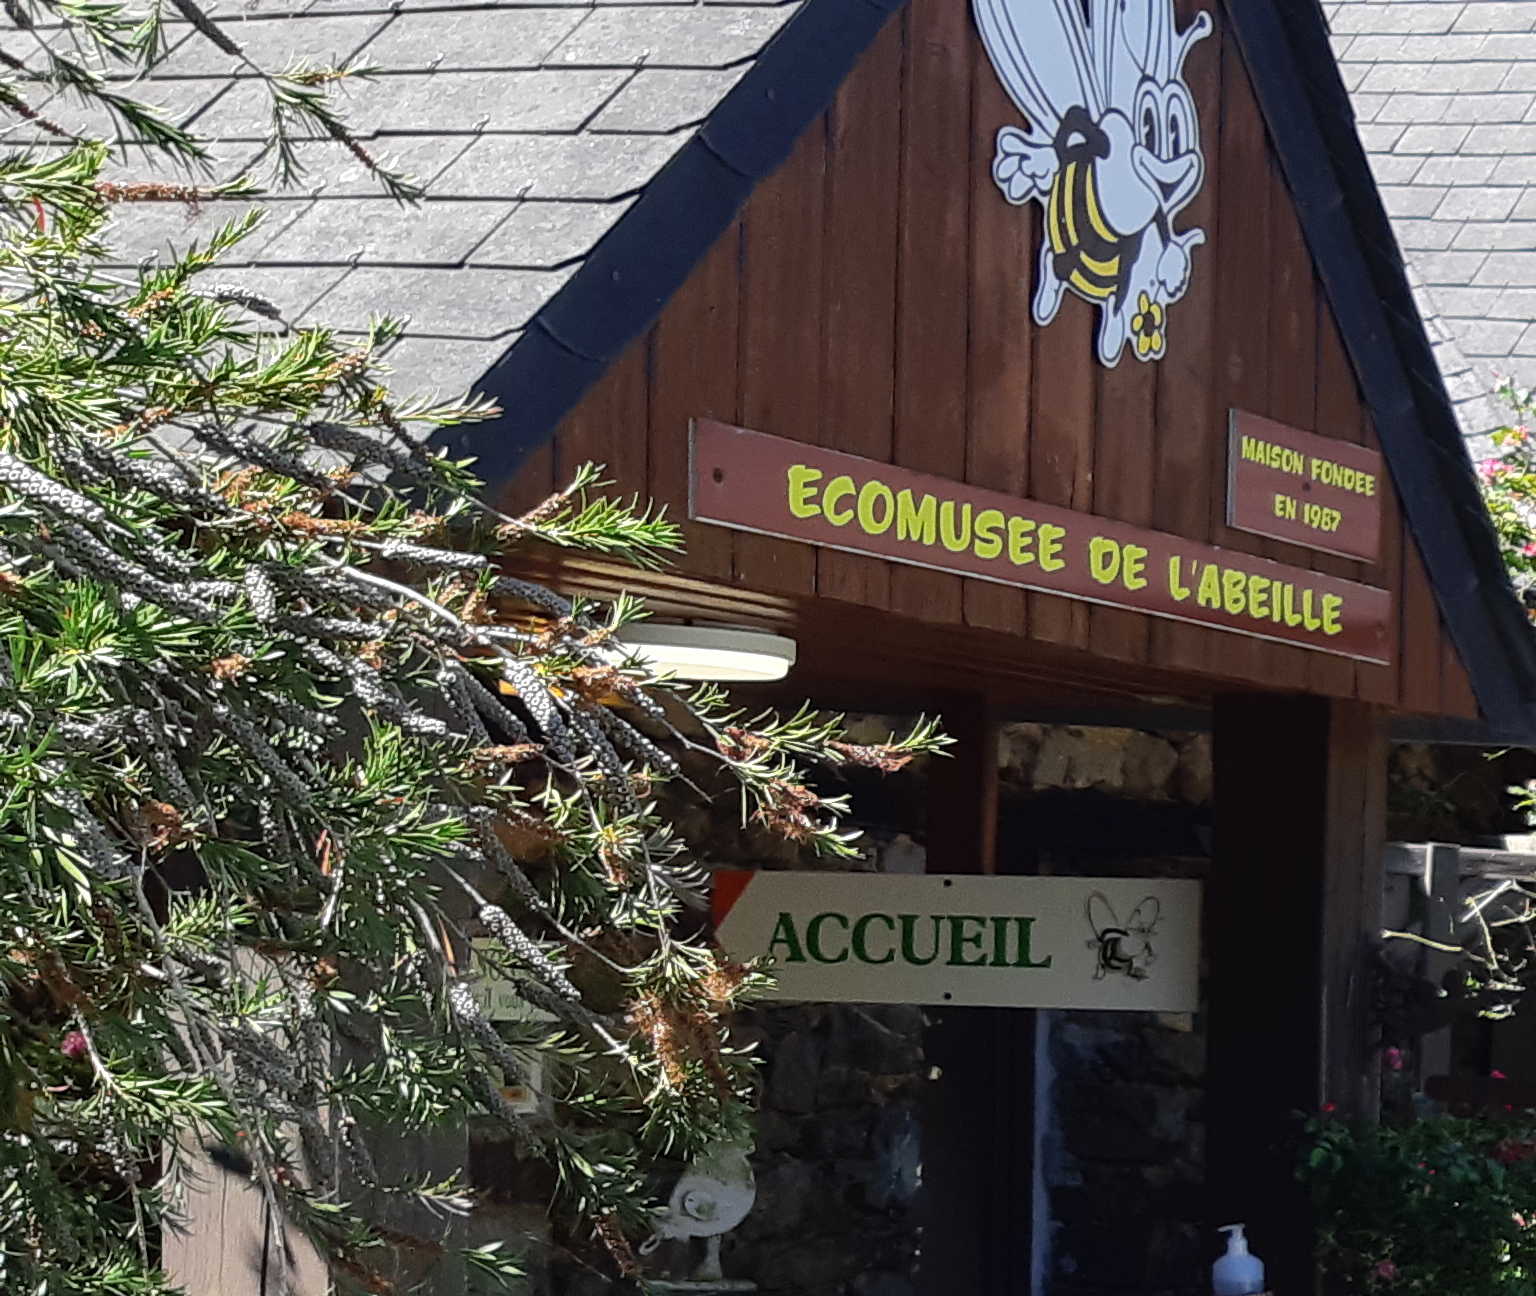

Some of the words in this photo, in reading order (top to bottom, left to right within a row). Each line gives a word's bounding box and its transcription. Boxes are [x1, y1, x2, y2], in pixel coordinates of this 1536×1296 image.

[1241, 434, 1304, 477] MAISON
[1311, 457, 1376, 497] FONDEE
[1274, 493, 1297, 521] EN
[1304, 503, 1342, 532] 1987
[787, 464, 1067, 573] ECOMUSEE
[1089, 536, 1149, 591] DE
[1169, 555, 1344, 635] L'ABEILLE
[766, 911, 1053, 968] ACCUEIL
